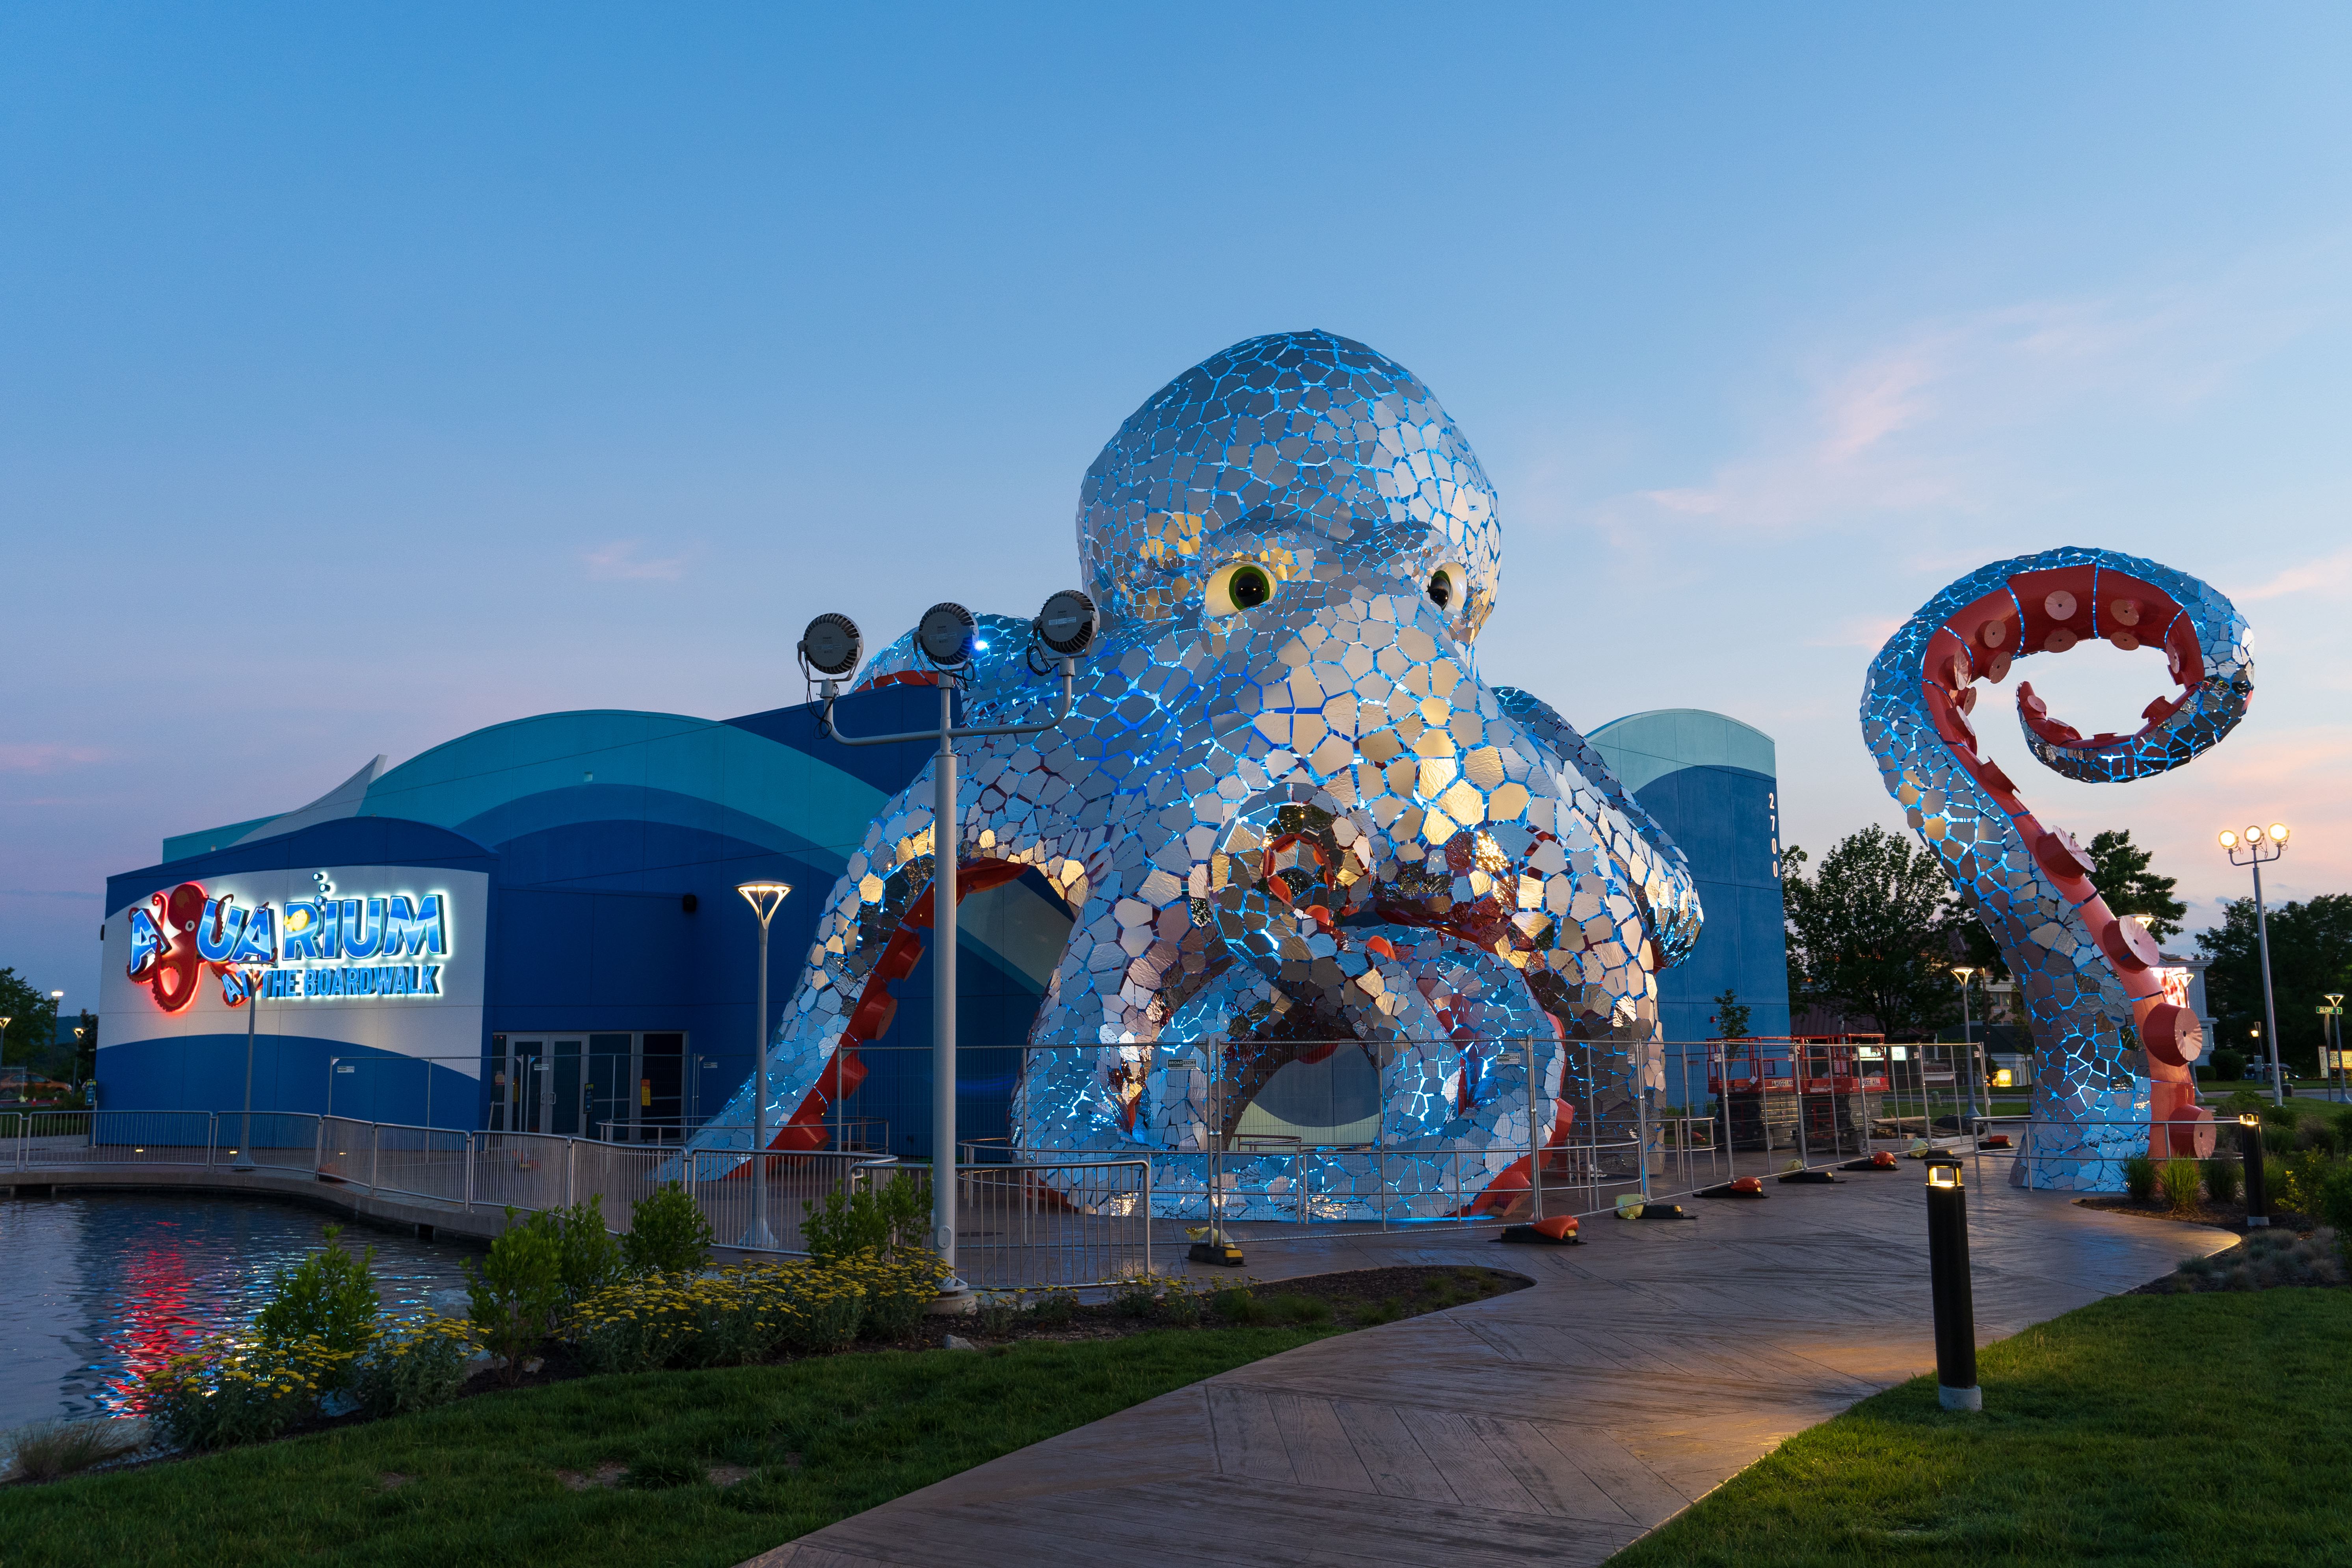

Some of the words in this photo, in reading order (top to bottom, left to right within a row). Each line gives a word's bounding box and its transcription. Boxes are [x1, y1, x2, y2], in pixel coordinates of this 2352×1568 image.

[1769, 792, 1778, 878] 2700
[221, 970, 250, 1003] AT
[261, 969, 300, 998] THE
[304, 965, 438, 997] BOARDWALK
